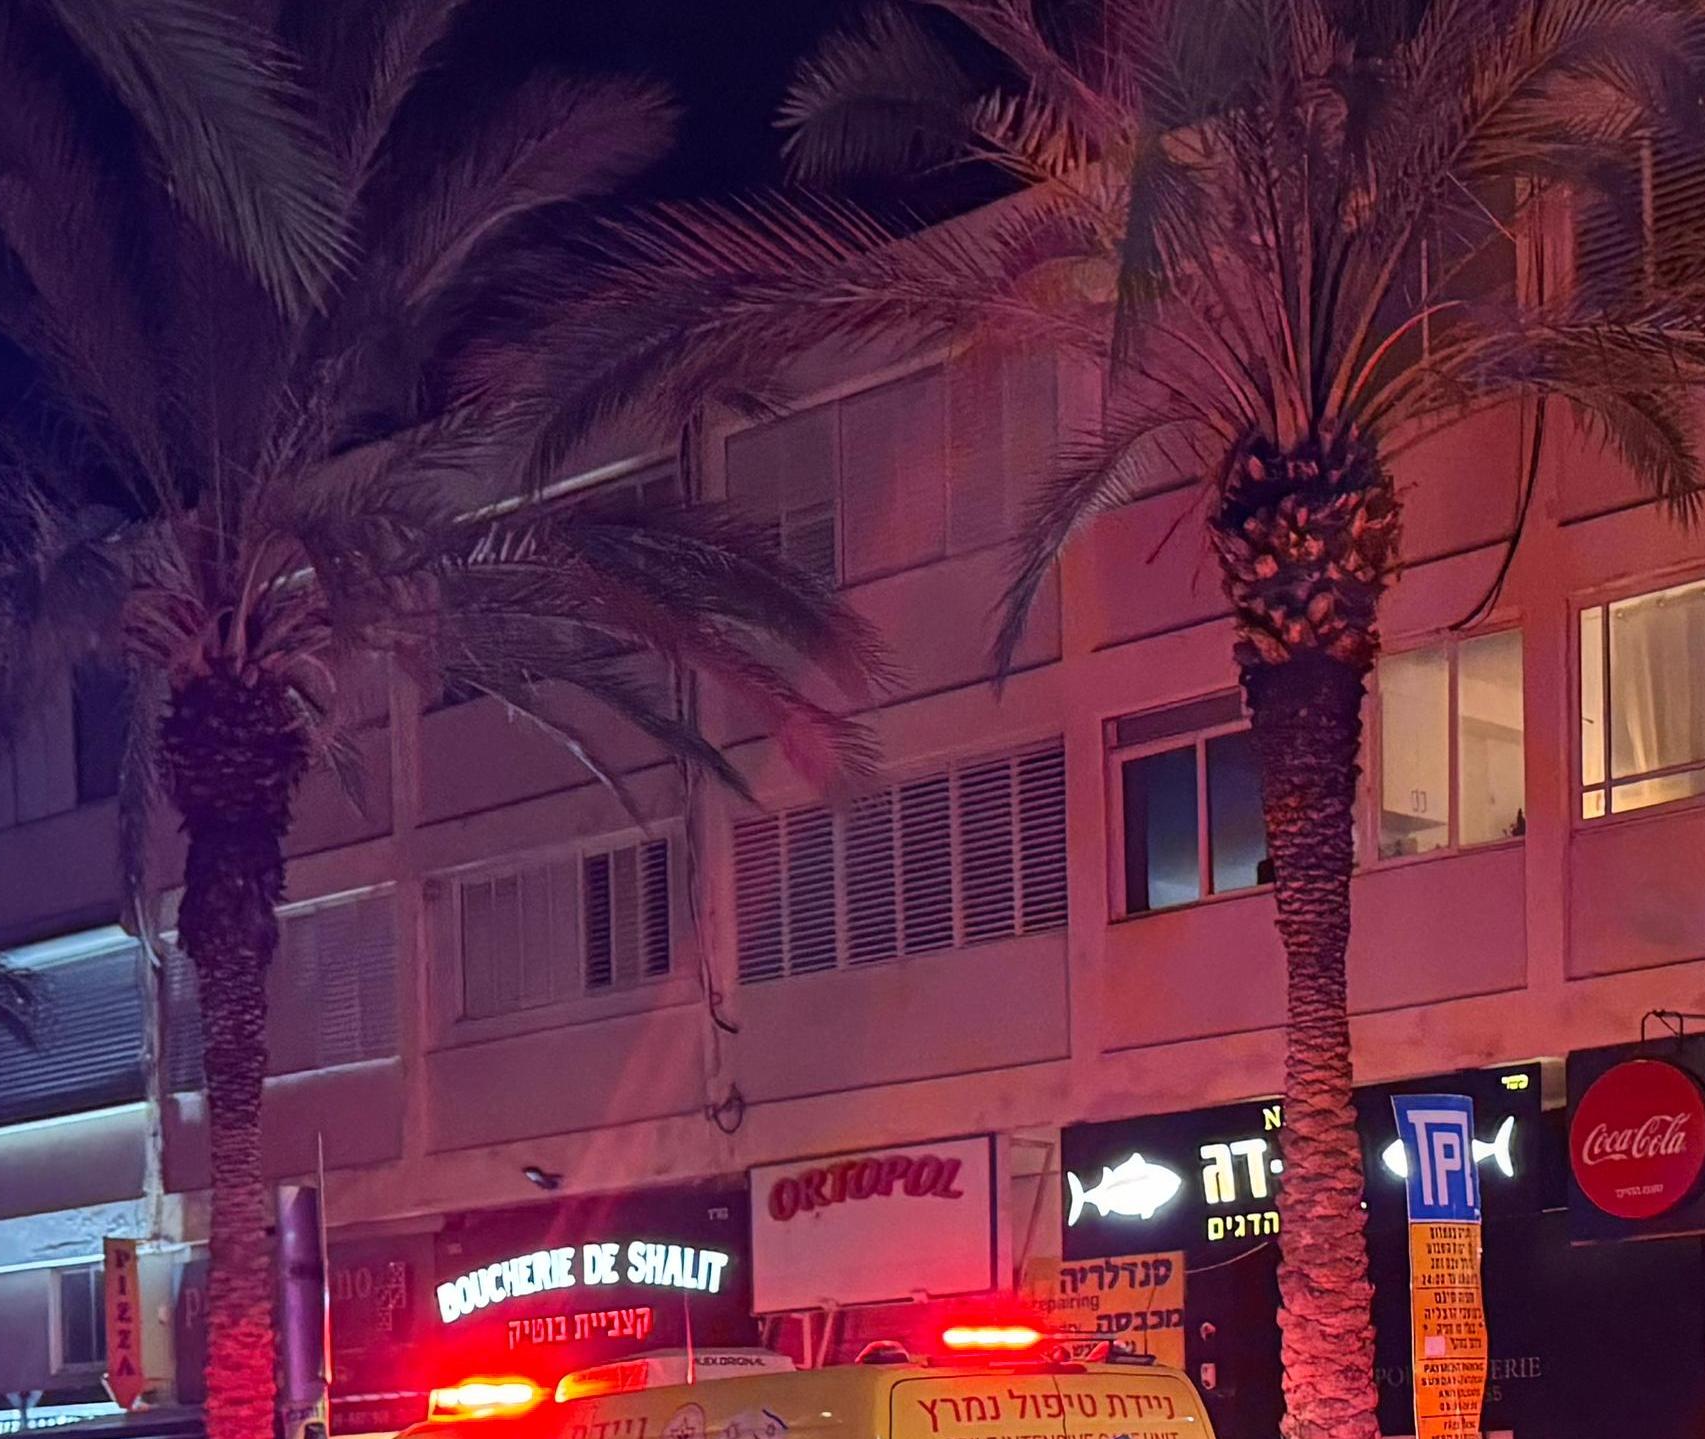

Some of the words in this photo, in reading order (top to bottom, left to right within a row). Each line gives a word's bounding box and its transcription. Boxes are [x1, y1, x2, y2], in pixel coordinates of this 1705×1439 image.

[1583, 1112, 1692, 1165] Coca-Cola
[768, 1154, 964, 1221] ORTOPOL
[1207, 1211, 1280, 1241] הדגים
[437, 1247, 576, 1323] BOUCHERIE
[583, 1243, 620, 1285] DE
[627, 1241, 728, 1293] SHALIT
[1060, 1258, 1173, 1294] סנדלריה
[114, 1249, 137, 1377] PIZZA
[575, 1307, 652, 1340] קצביית
[1096, 1308, 1184, 1334] מכבסה
[508, 1317, 567, 1350] בוטיק
[918, 1394, 1001, 1432] נמרץ
[1007, 1388, 1096, 1420] טיפול
[1107, 1393, 1176, 1420] ניידת
